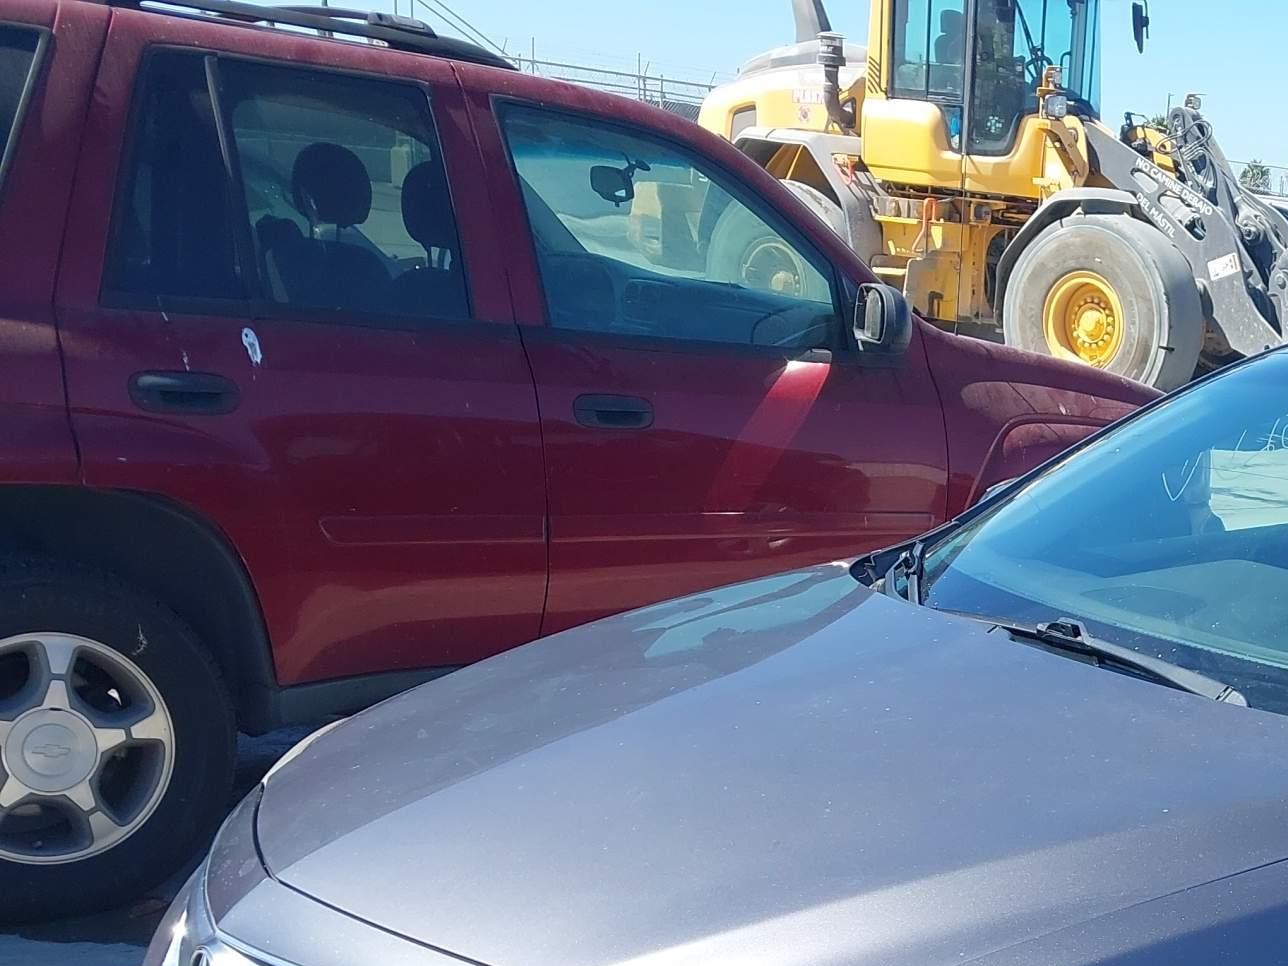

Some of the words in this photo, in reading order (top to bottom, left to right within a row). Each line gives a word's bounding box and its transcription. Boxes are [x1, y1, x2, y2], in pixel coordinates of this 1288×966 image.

[1135, 157, 1149, 172] NO
[1150, 167, 1182, 195] CAMINE
[1181, 190, 1213, 216] DEBAJO
[1136, 192, 1150, 212] DEL
[1149, 207, 1177, 238] MÁSTIL
